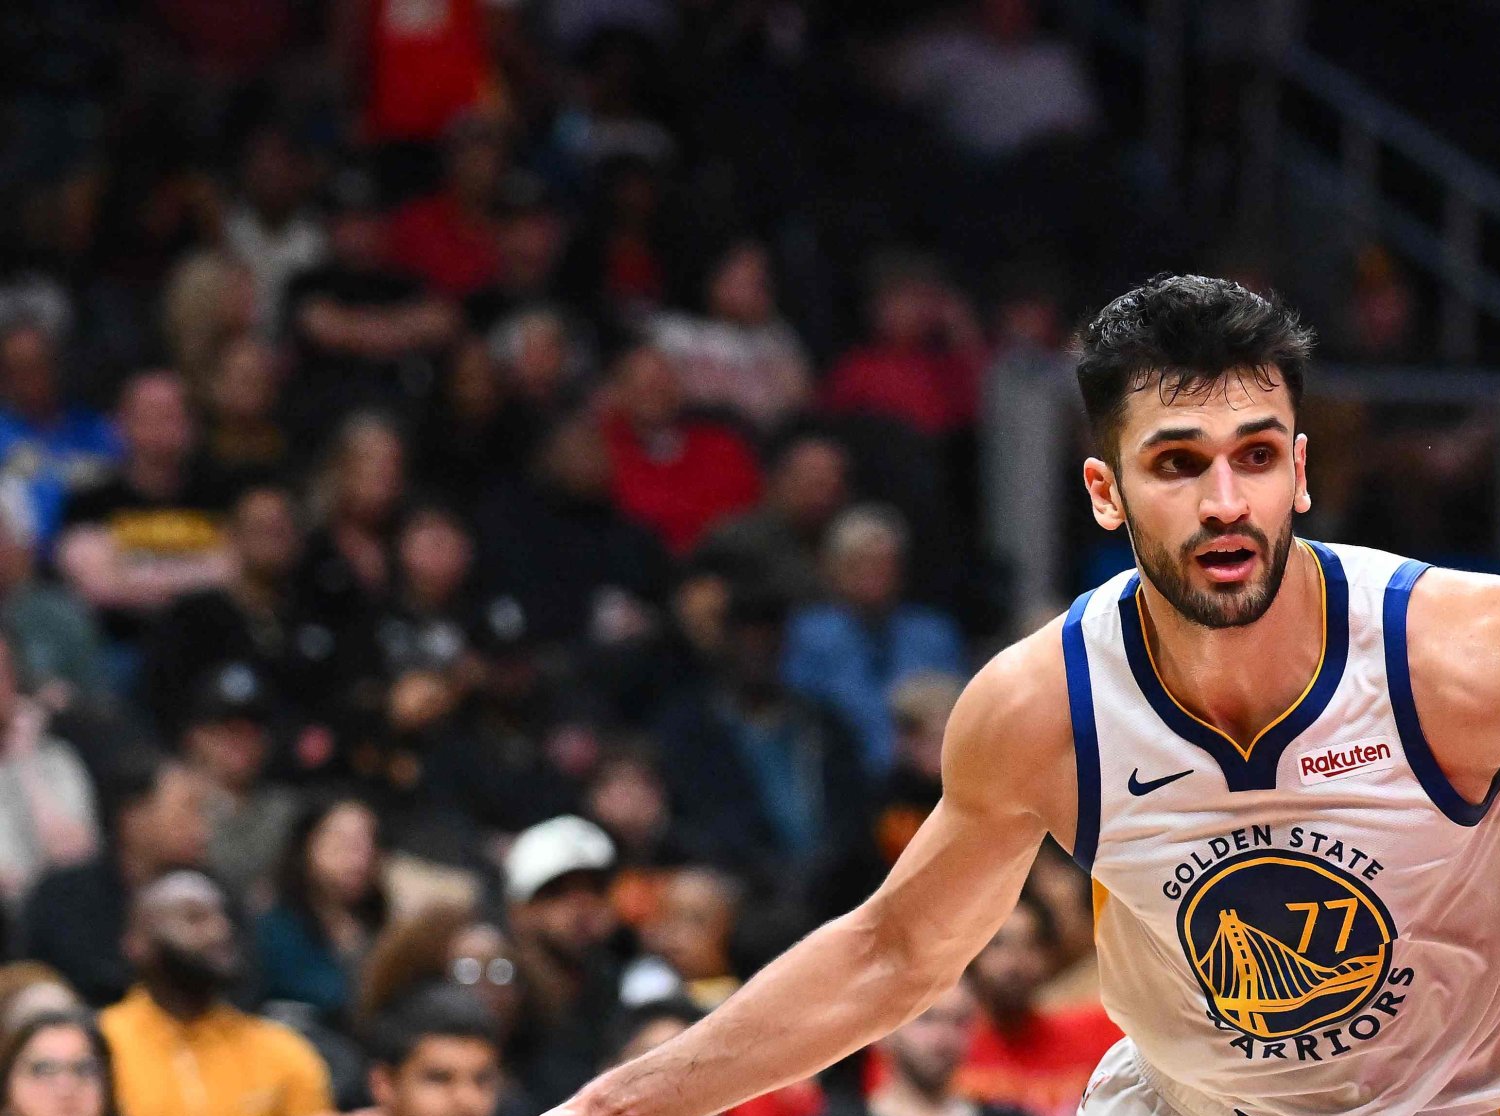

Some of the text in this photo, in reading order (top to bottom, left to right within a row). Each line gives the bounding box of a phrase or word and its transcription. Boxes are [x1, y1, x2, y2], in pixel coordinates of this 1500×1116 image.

[1301, 743, 1391, 777] Rakuten
[1162, 824, 1384, 900] GOLDEN STATE
[1285, 897, 1358, 954] 77
